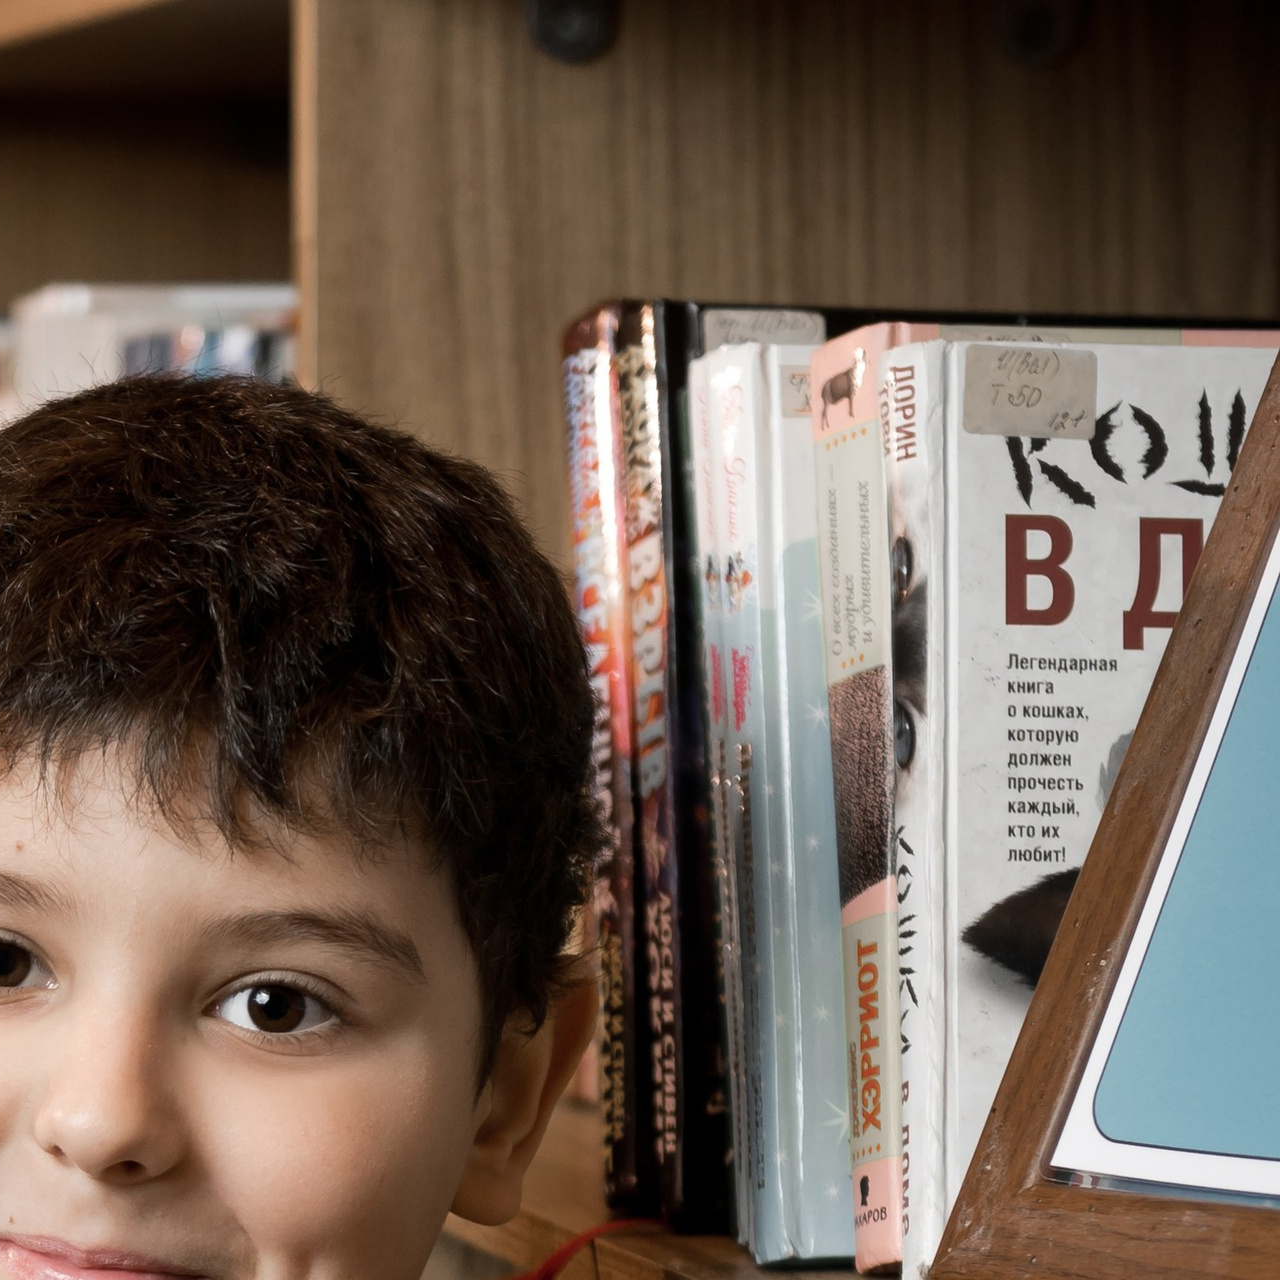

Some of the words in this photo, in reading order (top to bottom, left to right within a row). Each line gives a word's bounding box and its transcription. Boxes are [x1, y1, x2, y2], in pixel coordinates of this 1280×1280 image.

[890, 364, 917, 462] ДОРИН
[1004, 514, 1076, 626] В
[1006, 653, 1118, 674] Легендарная
[1007, 680, 1054, 695] книга
[1007, 705, 1017, 718] о
[1022, 704, 1089, 722] кошках,
[1007, 728, 1079, 746] которую
[1007, 752, 1072, 768] должен
[1007, 776, 1084, 793] прочесть
[1007, 798, 1080, 817] каждый,
[1007, 824, 1036, 838] кто
[1041, 825, 1061, 838] их
[1007, 846, 1066, 863] любит!
[857, 939, 882, 1135] ХЭРРИОТ
[662, 1033, 677, 1154] СТИВЕН
